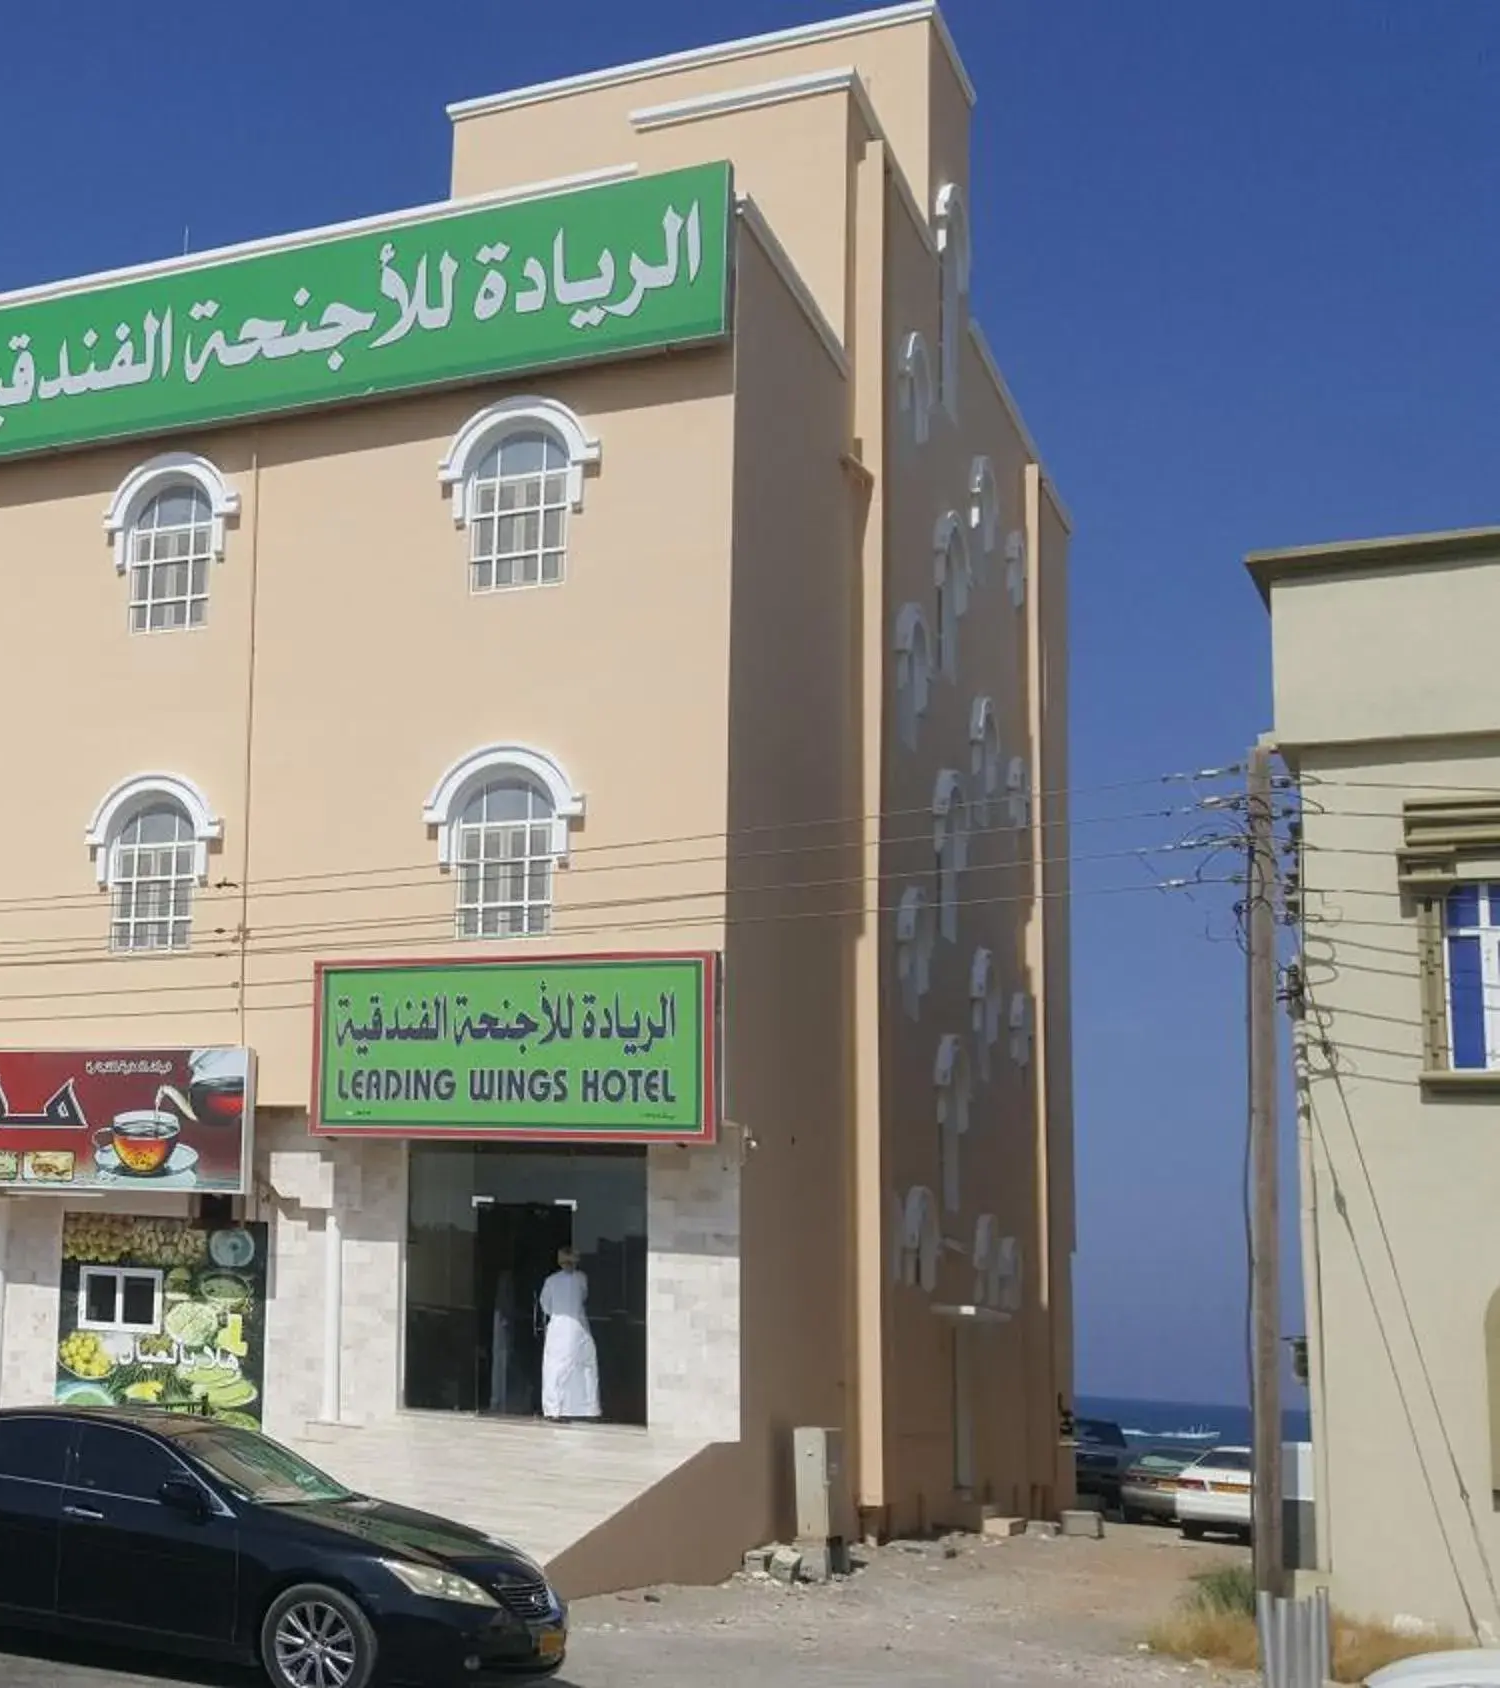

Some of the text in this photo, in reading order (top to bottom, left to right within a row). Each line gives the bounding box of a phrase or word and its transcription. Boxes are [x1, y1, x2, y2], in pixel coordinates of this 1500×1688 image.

[182, 242, 461, 384] للأجنحة
[472, 199, 704, 330] الريادة
[335, 980, 676, 1056] الريادة للأجنحة الفندقية
[337, 1068, 677, 1103] LEADING WINGS HOTEL
